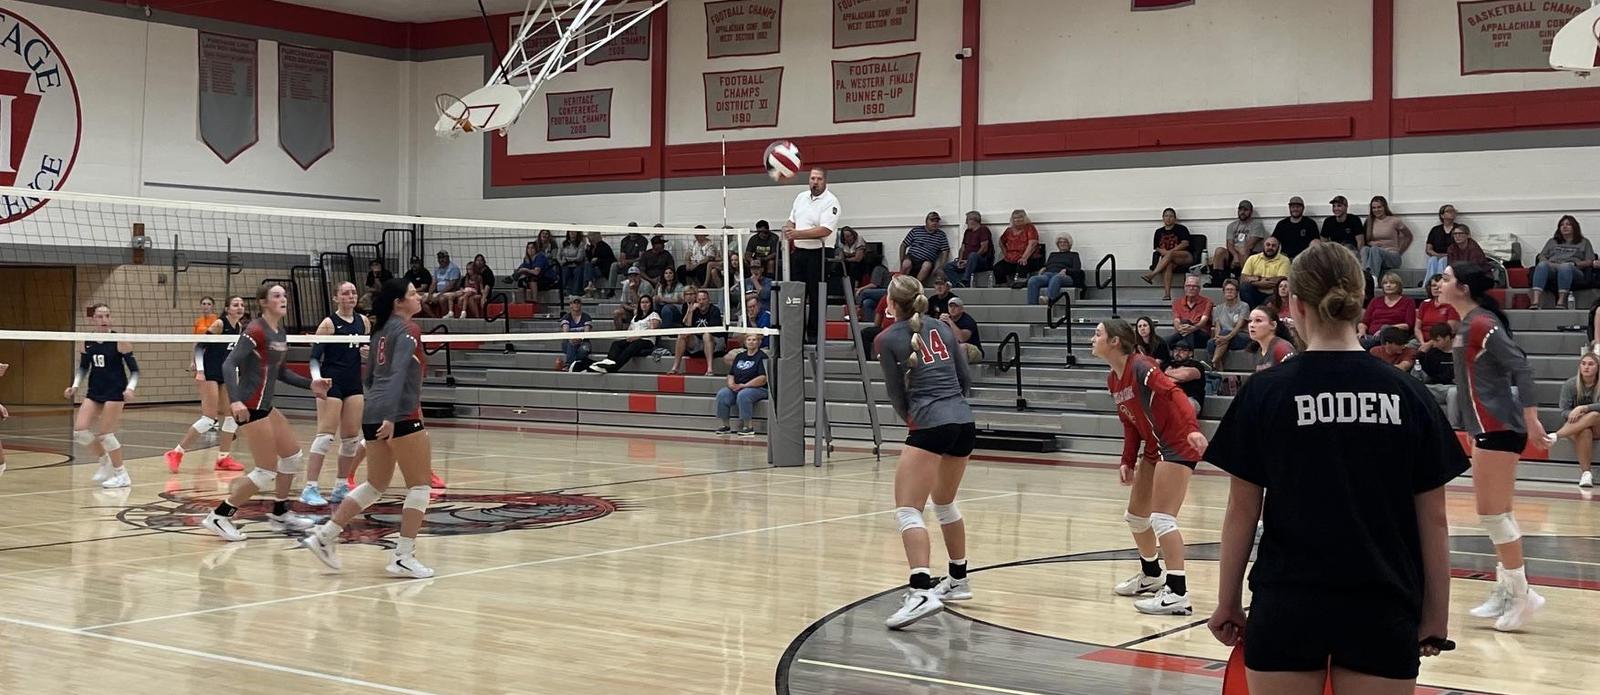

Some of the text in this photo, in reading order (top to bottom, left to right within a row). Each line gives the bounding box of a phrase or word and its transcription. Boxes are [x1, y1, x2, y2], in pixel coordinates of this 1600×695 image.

[710, 4, 776, 26] FOOTBALL CHAMPS
[1467, 2, 1536, 27] BASKETBALL
[1480, 20, 1541, 32] APPALACHIAN
[1539, 30, 1557, 38] GIRL
[849, 62, 899, 76] FOOTBALL
[720, 74, 764, 86] FOOTBALL
[850, 77, 885, 89] WESTERN
[889, 72, 914, 85] FINALS
[724, 87, 760, 98] CHAMPS
[845, 87, 903, 103] RUNNER-UP
[563, 95, 594, 106] HERITAGE
[716, 100, 755, 112] DISTRICT
[559, 104, 600, 116] CONFERENCE
[551, 113, 607, 126] FOOTBALL CHAMPS
[914, 329, 950, 365] 14
[92, 354, 105, 368] 18
[1294, 392, 1402, 426] BODEN
